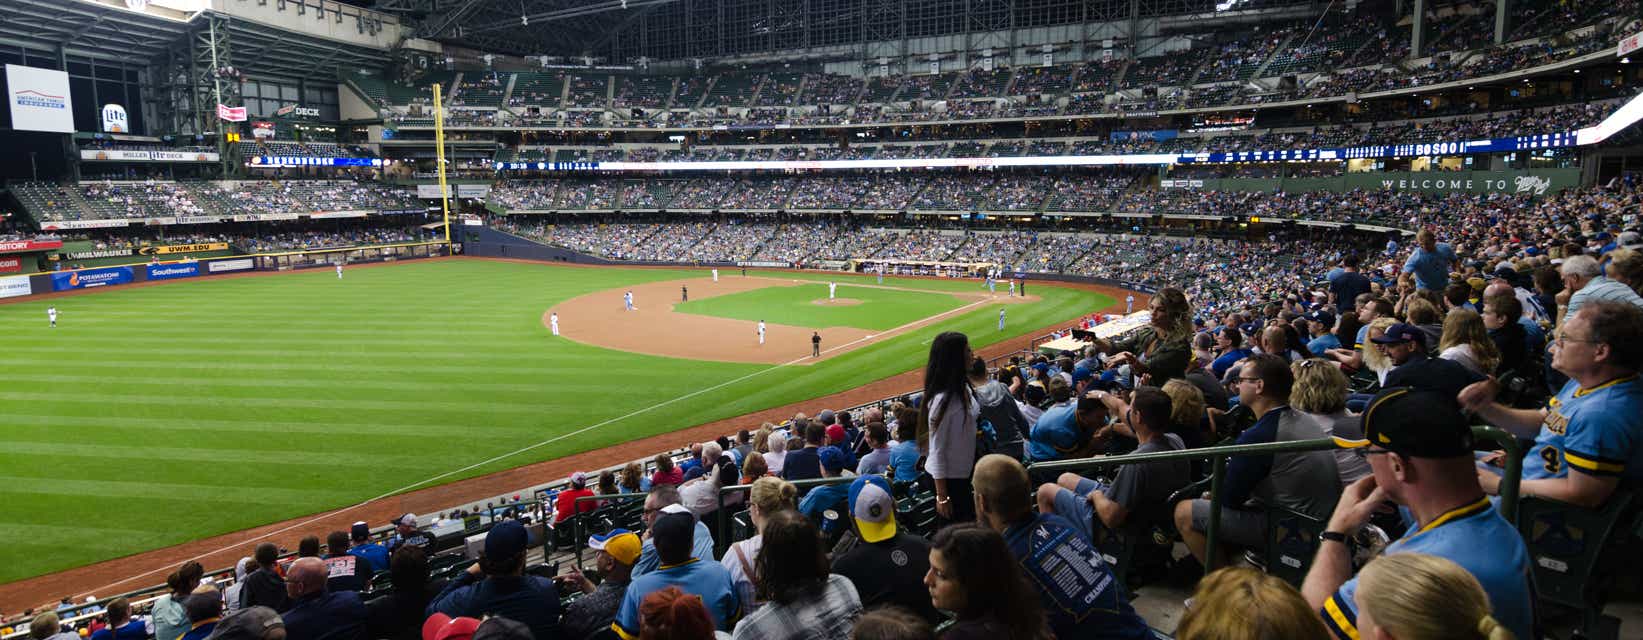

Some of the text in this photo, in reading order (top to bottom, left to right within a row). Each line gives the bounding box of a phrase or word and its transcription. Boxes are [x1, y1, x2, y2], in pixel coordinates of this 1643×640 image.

[106, 109, 125, 122] Lite
[295, 107, 320, 116] DECK
[1382, 179, 1473, 190] WELCOME
[1485, 180, 1506, 190] TO
[78, 272, 120, 281] POTAWATOMI
[152, 267, 190, 276] Southwest
[1084, 574, 1113, 604] CHAMPION
